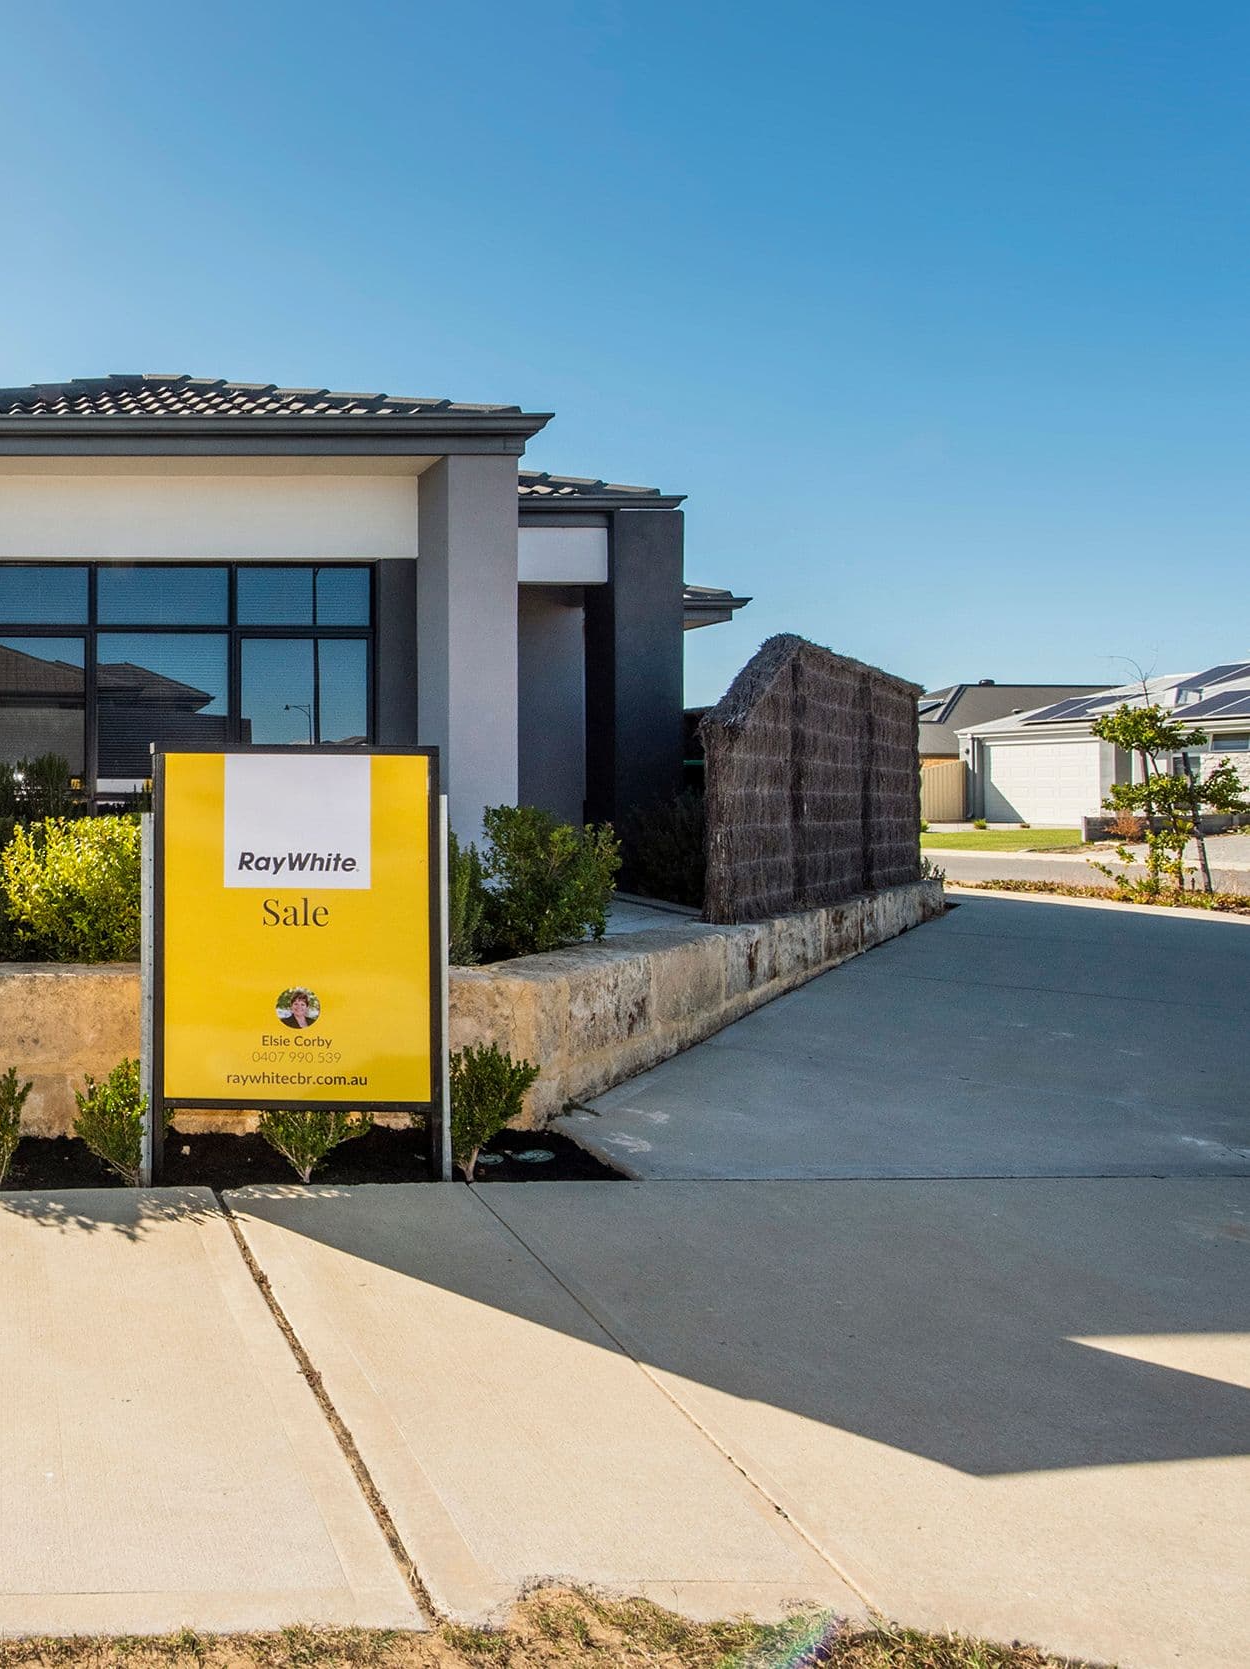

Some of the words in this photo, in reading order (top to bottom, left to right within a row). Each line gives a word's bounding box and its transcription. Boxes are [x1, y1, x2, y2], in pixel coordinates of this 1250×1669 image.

[262, 898, 329, 927] Sale
[261, 1035, 291, 1047] Elsie
[293, 1035, 333, 1049] Corby
[251, 1051, 285, 1063] 0407
[288, 1051, 314, 1064] 990
[317, 1051, 342, 1064] 539
[226, 1071, 368, 1087] raywhitecbr.com.au
